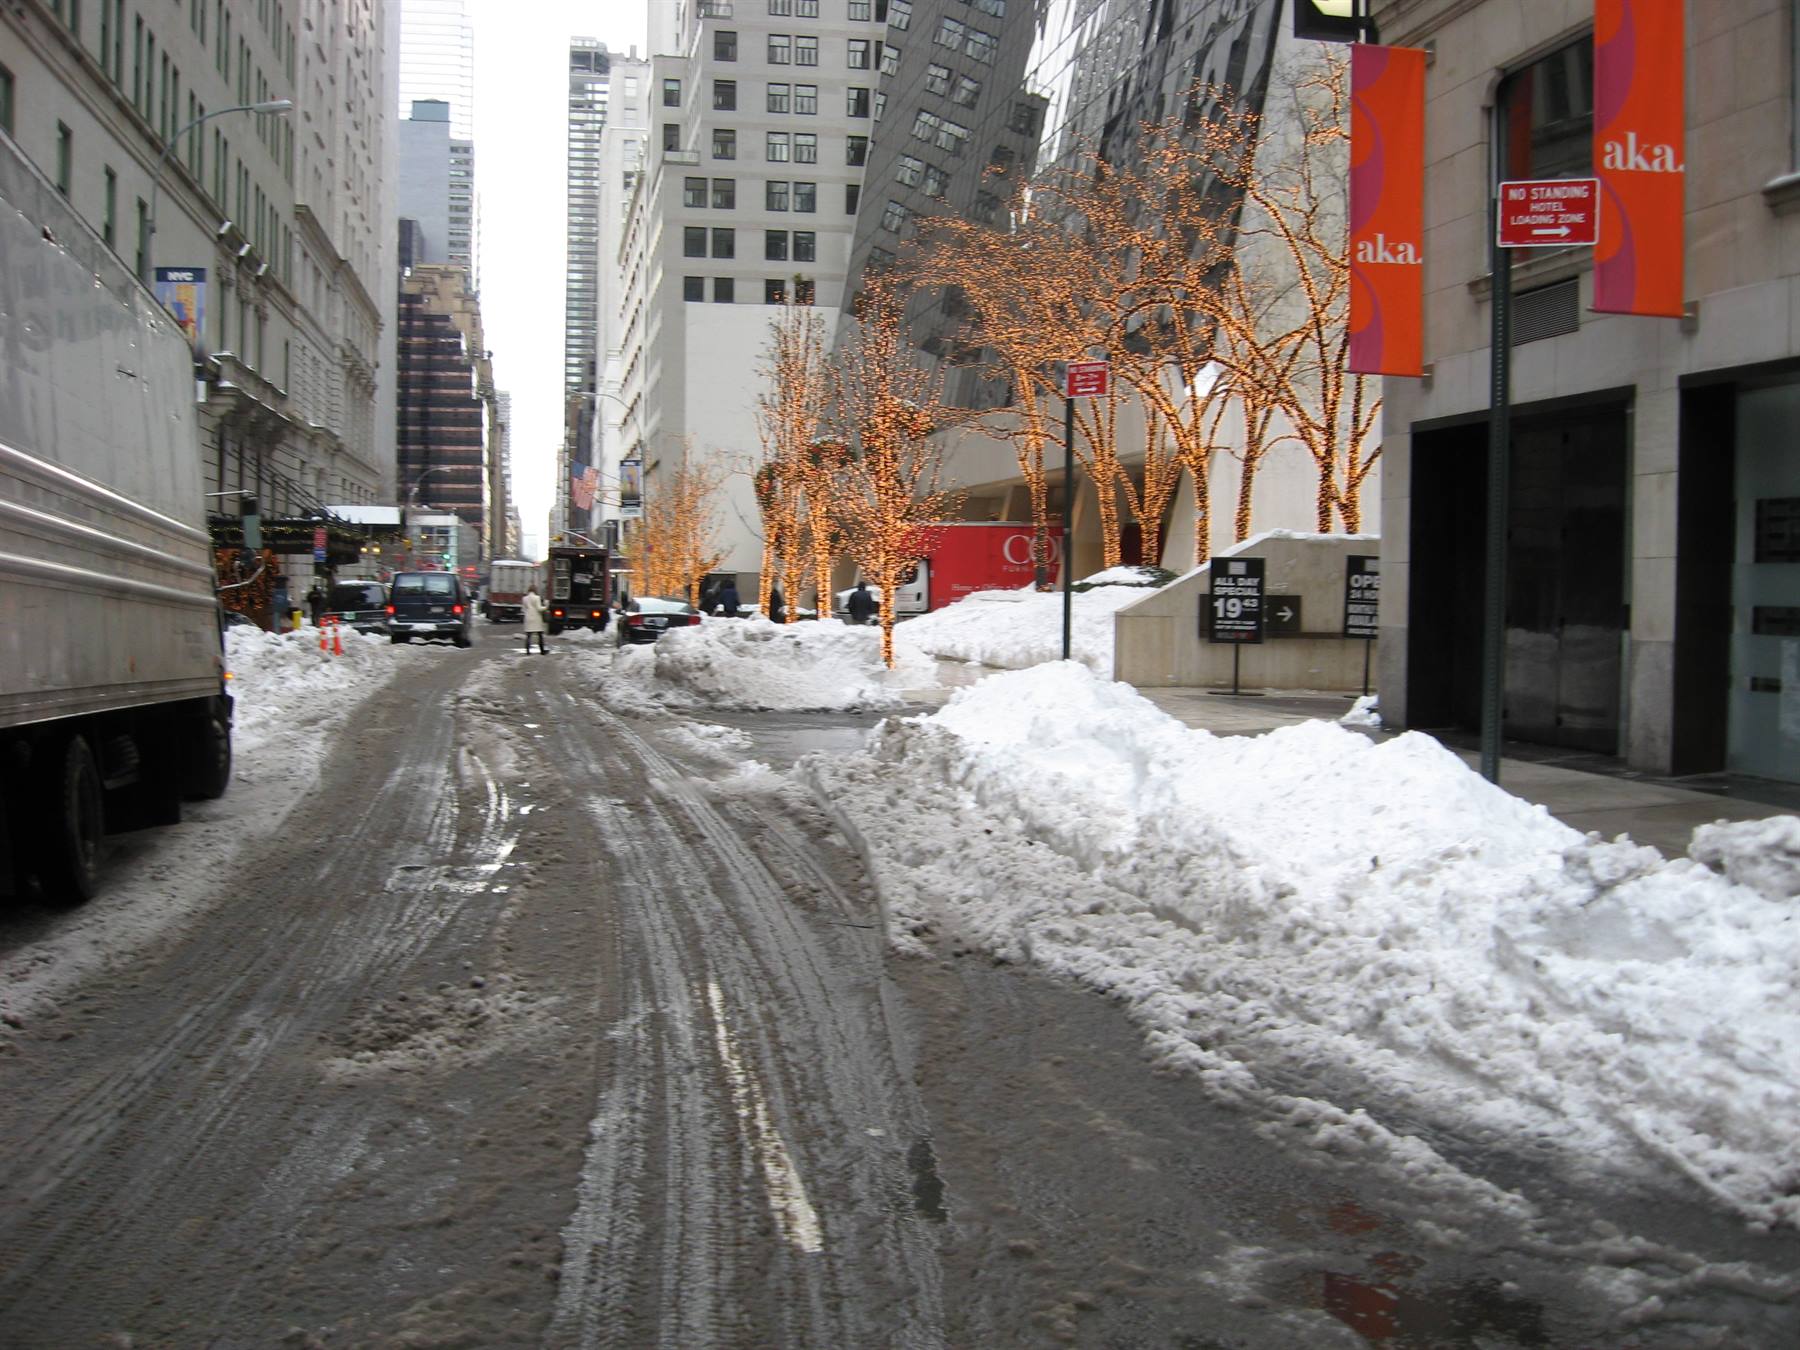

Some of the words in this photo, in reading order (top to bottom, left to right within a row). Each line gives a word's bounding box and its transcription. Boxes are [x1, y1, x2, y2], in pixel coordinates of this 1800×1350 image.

[1508, 188, 1527, 201] NO
[1529, 186, 1590, 200] STANDING
[1530, 202, 1566, 212] HOTEL
[1510, 215, 1555, 225] LOADING
[1557, 213, 1586, 224] ZONE
[167, 271, 194, 281] NYC
[1213, 577, 1236, 586] ALL
[1237, 577, 1261, 586] DAY
[1213, 586, 1261, 596] SPECIAL
